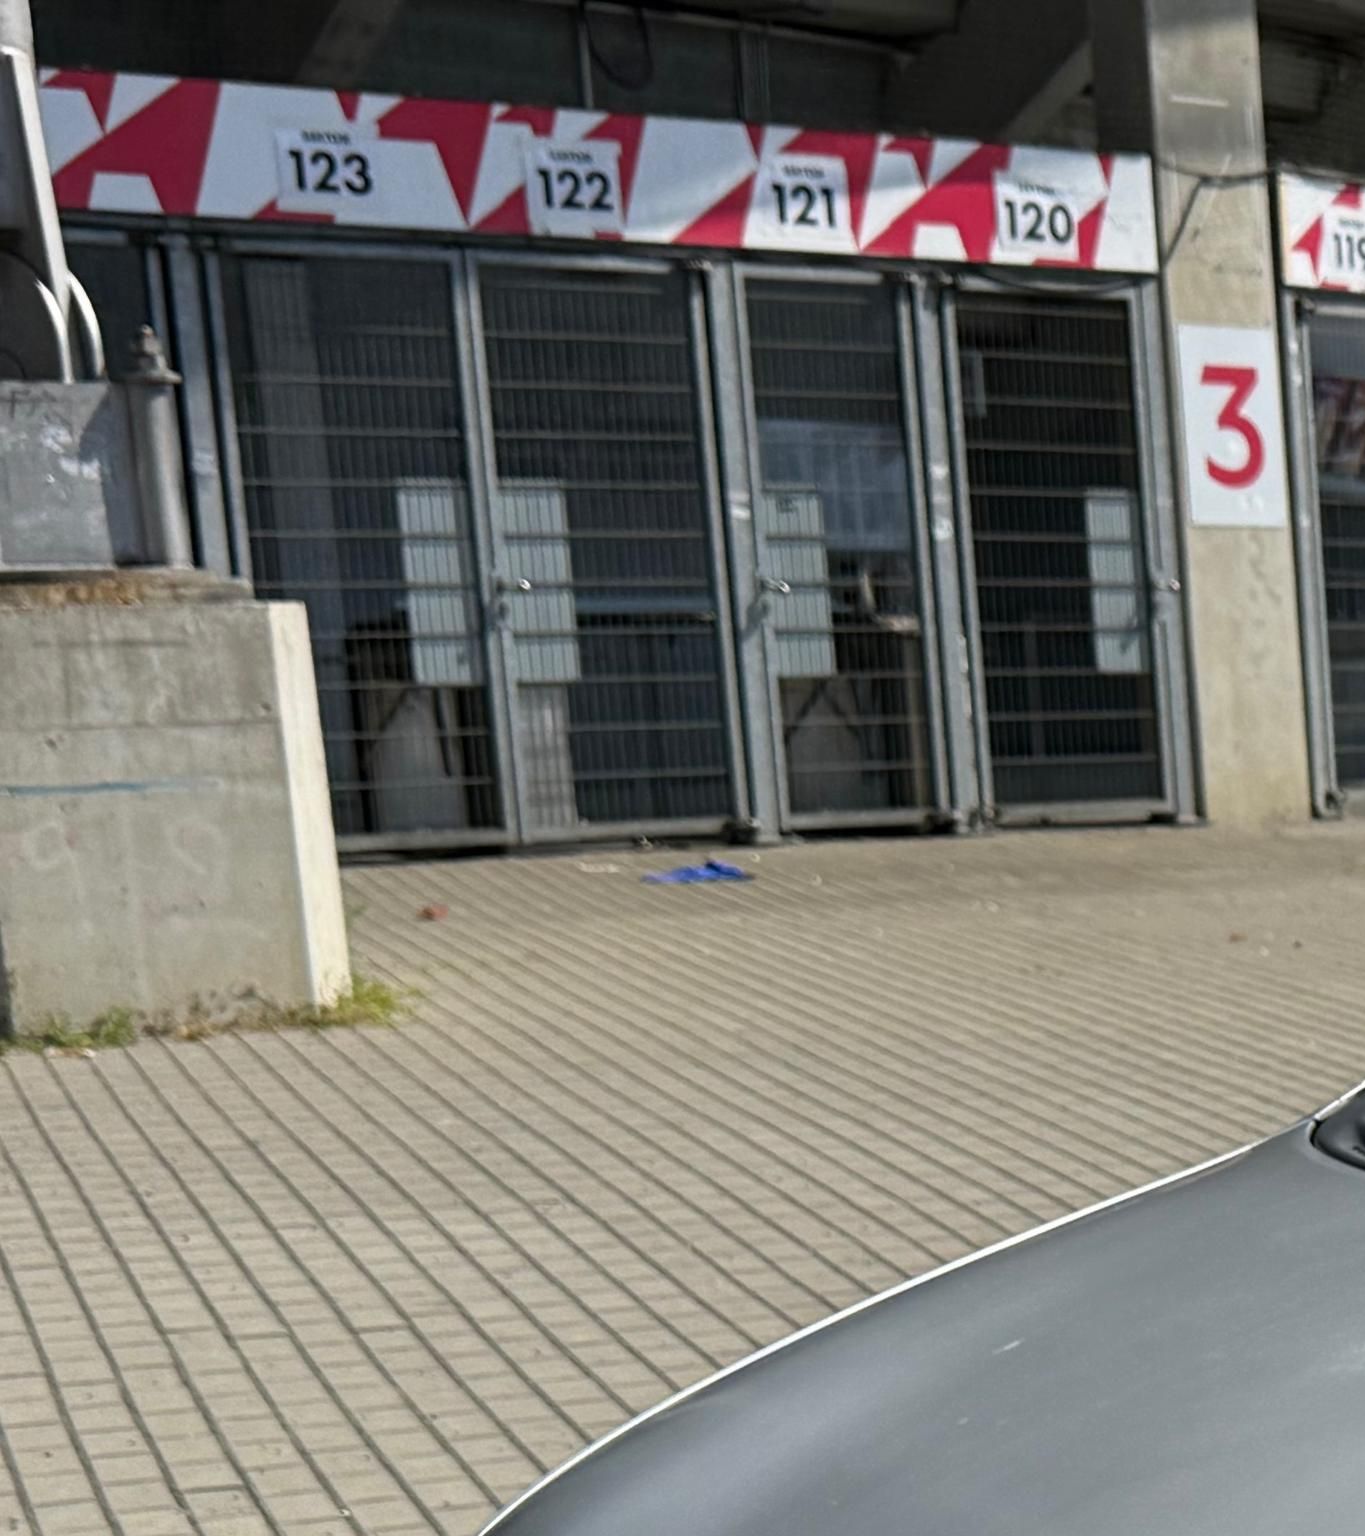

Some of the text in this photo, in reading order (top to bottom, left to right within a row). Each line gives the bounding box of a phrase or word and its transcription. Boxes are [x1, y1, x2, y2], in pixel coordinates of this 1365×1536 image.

[289, 149, 372, 195] 123
[537, 167, 614, 211] 122
[772, 183, 836, 228] 121
[1004, 200, 1074, 243] 120
[1201, 365, 1265, 490] 3
